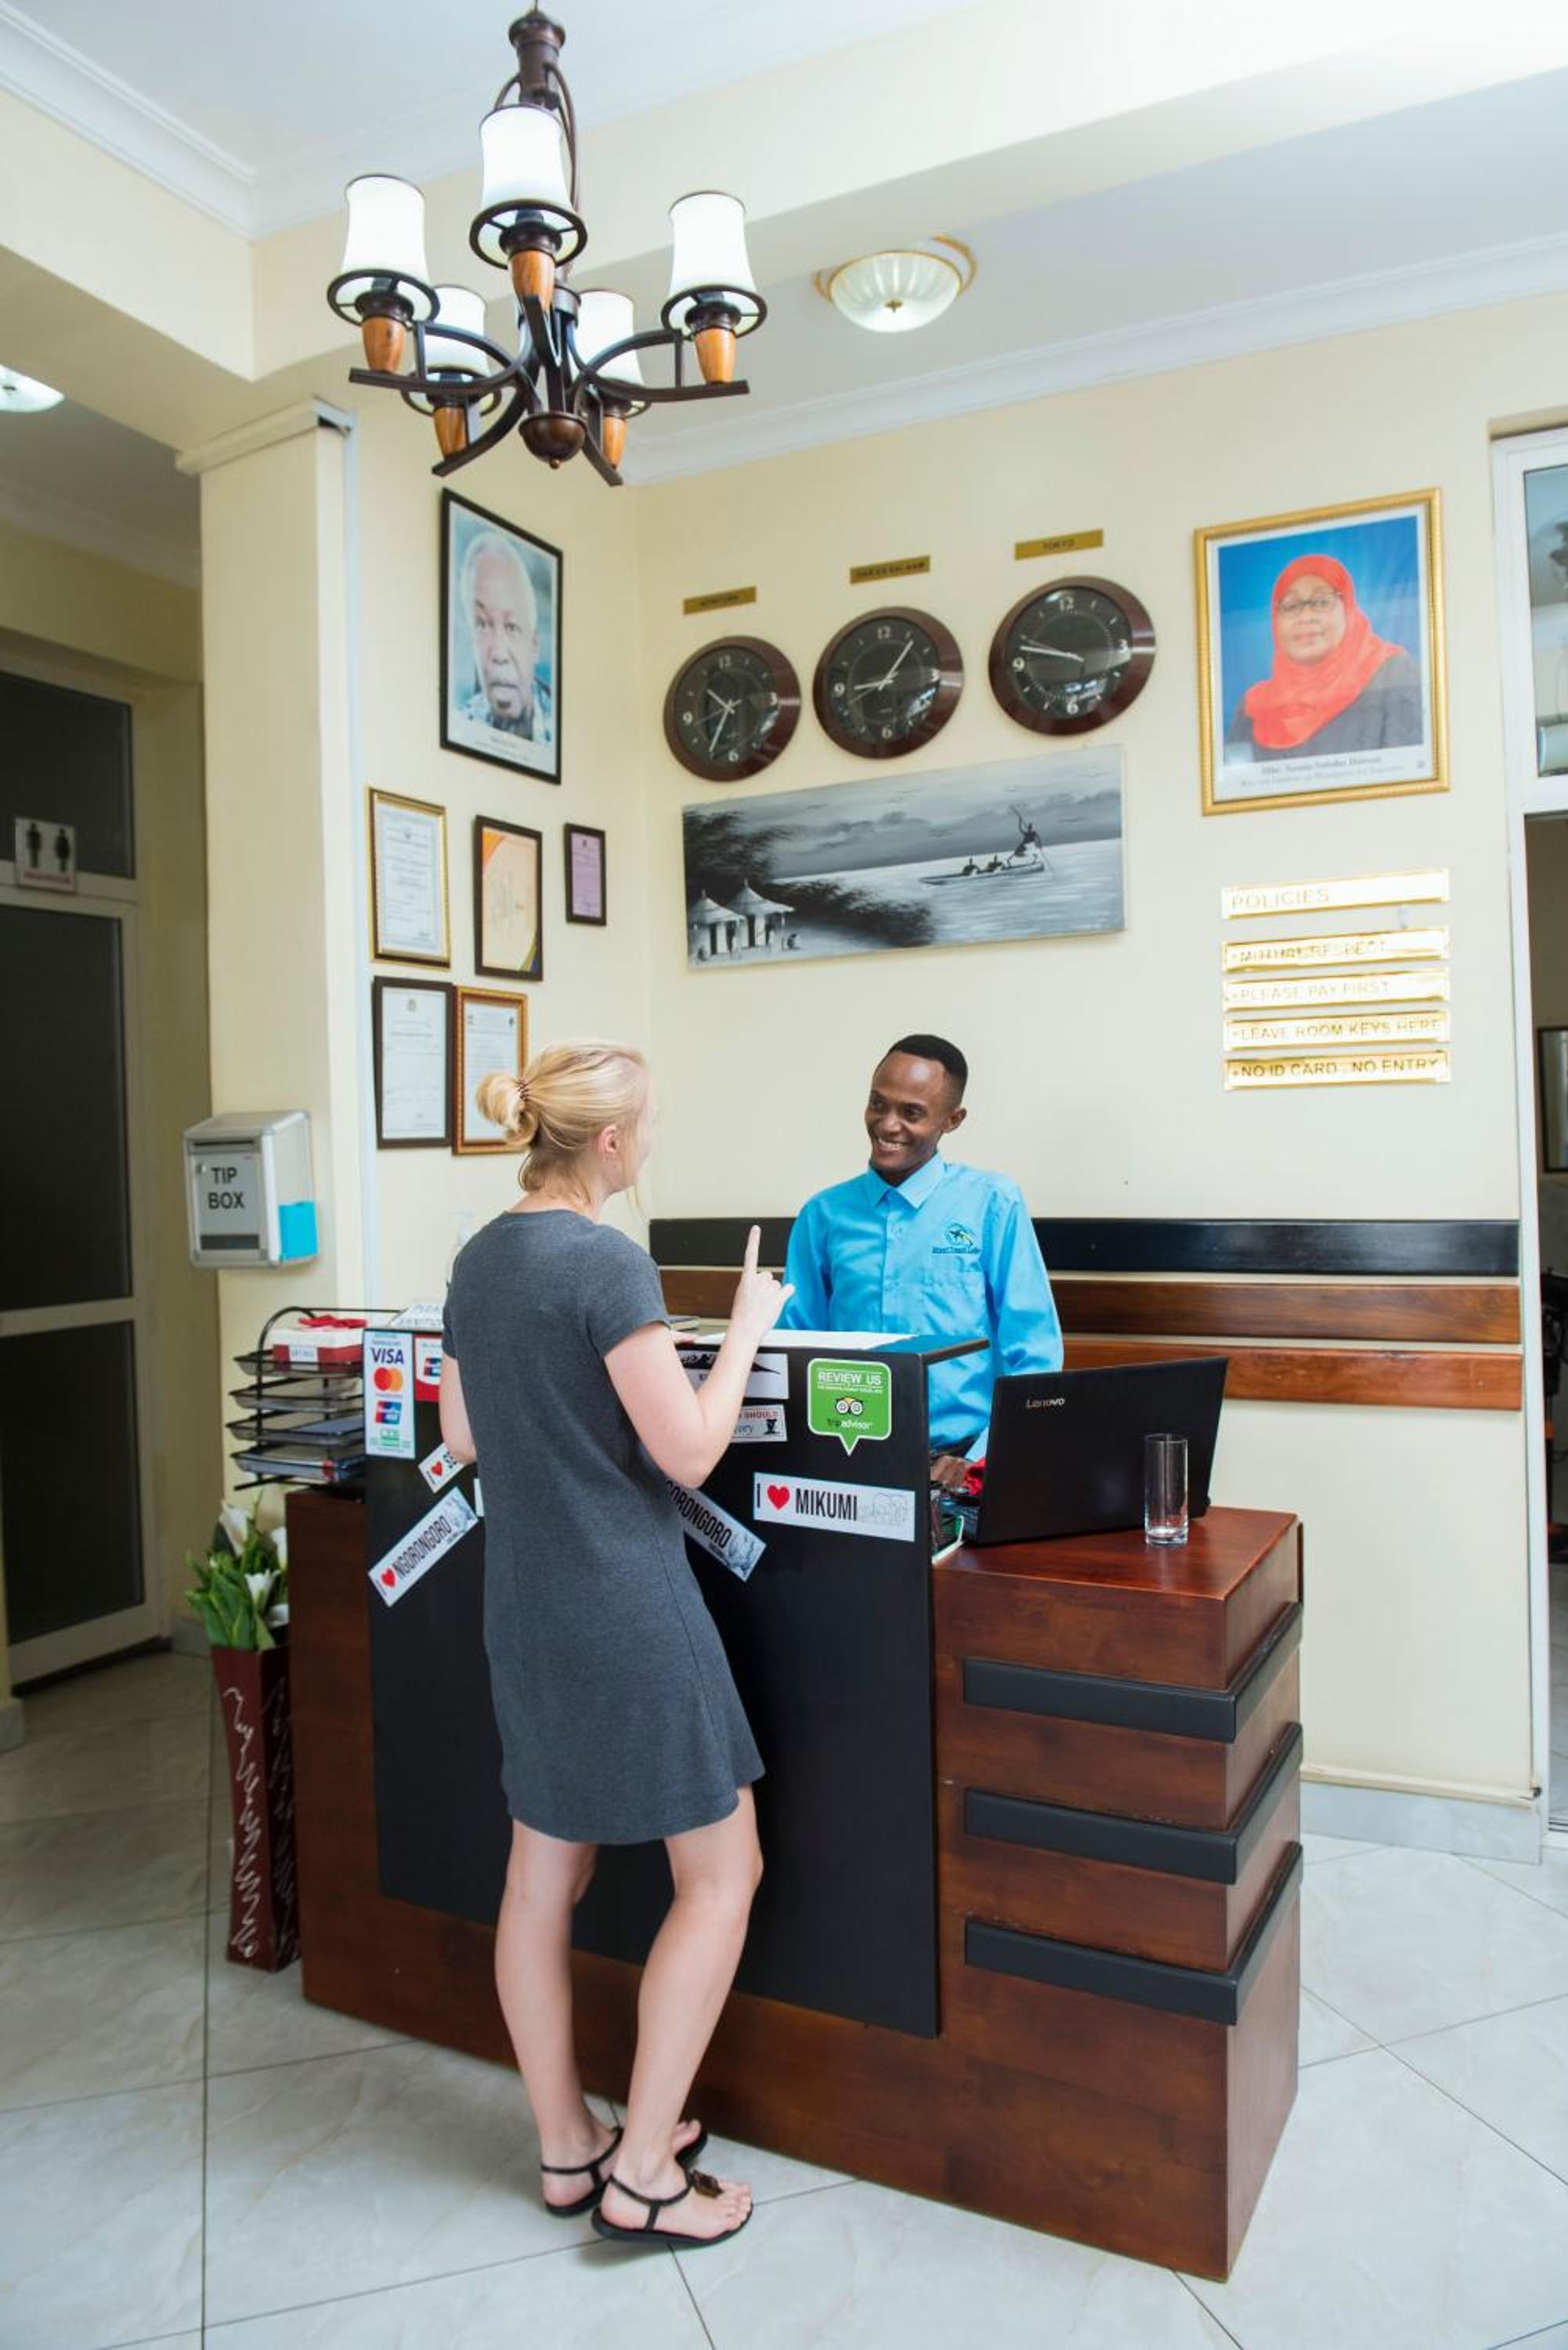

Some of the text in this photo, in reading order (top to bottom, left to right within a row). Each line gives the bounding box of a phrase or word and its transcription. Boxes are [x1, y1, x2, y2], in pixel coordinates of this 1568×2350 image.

[1060, 596, 1074, 611] 12
[878, 626, 891, 639] 12
[1118, 638, 1129, 653] 3
[1012, 657, 1024, 671] 9
[834, 682, 845, 697] 9
[769, 692, 778, 706] 3
[1066, 699, 1078, 714] 6
[682, 711, 693, 725] 9
[881, 725, 893, 739] 6
[728, 749, 739, 762] 6
[1232, 888, 1329, 909] POLICIES
[1241, 1018, 1441, 1040] LEAVE ROOM KEYS HERE
[1241, 1058, 1438, 1077] NO ID CARD NO ENTRY
[211, 1166, 237, 1184] TIP
[208, 1191, 245, 1209] BOX
[370, 1348, 404, 1365] VISA
[818, 1371, 883, 1386] REVIEW US
[757, 1482, 858, 1521] I MIKUMI
[392, 1515, 452, 1578] NGORONGORO
